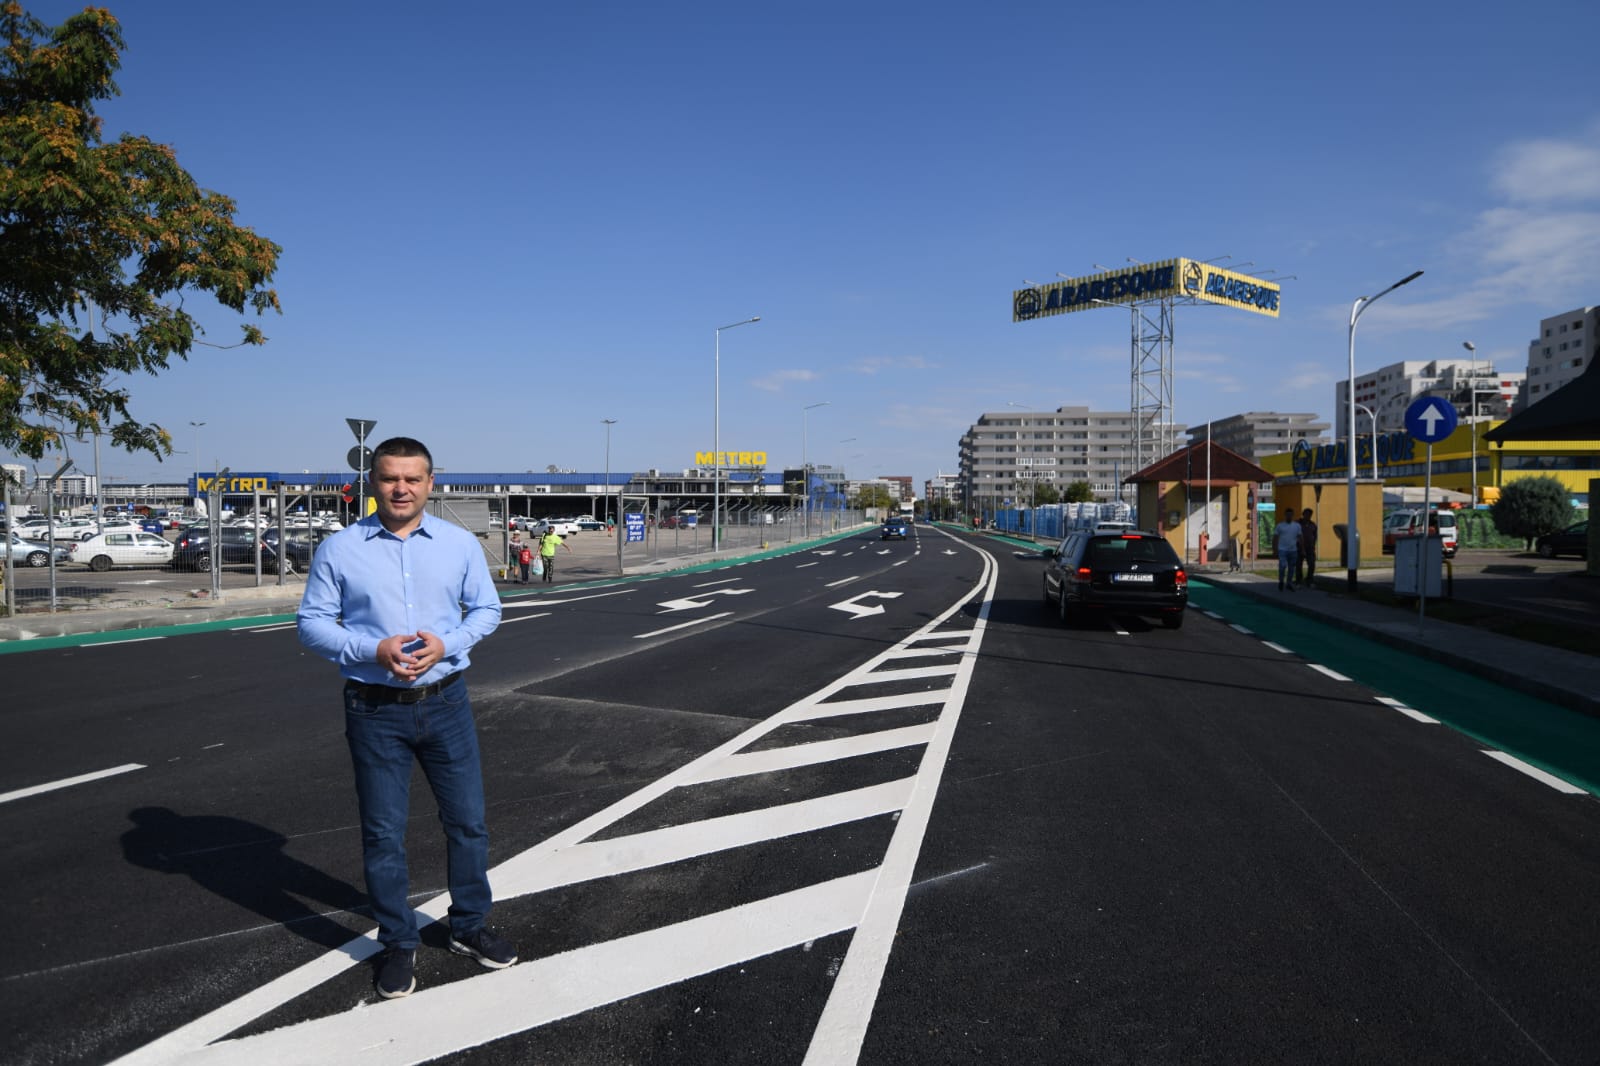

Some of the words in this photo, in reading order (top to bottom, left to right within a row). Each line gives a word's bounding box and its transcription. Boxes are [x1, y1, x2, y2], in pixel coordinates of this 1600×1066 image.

[1044, 265, 1174, 310] ARABESQUE
[1205, 272, 1280, 311] ARABESQUE
[695, 451, 767, 465] METRO
[1315, 431, 1415, 469] ARAESQUE
